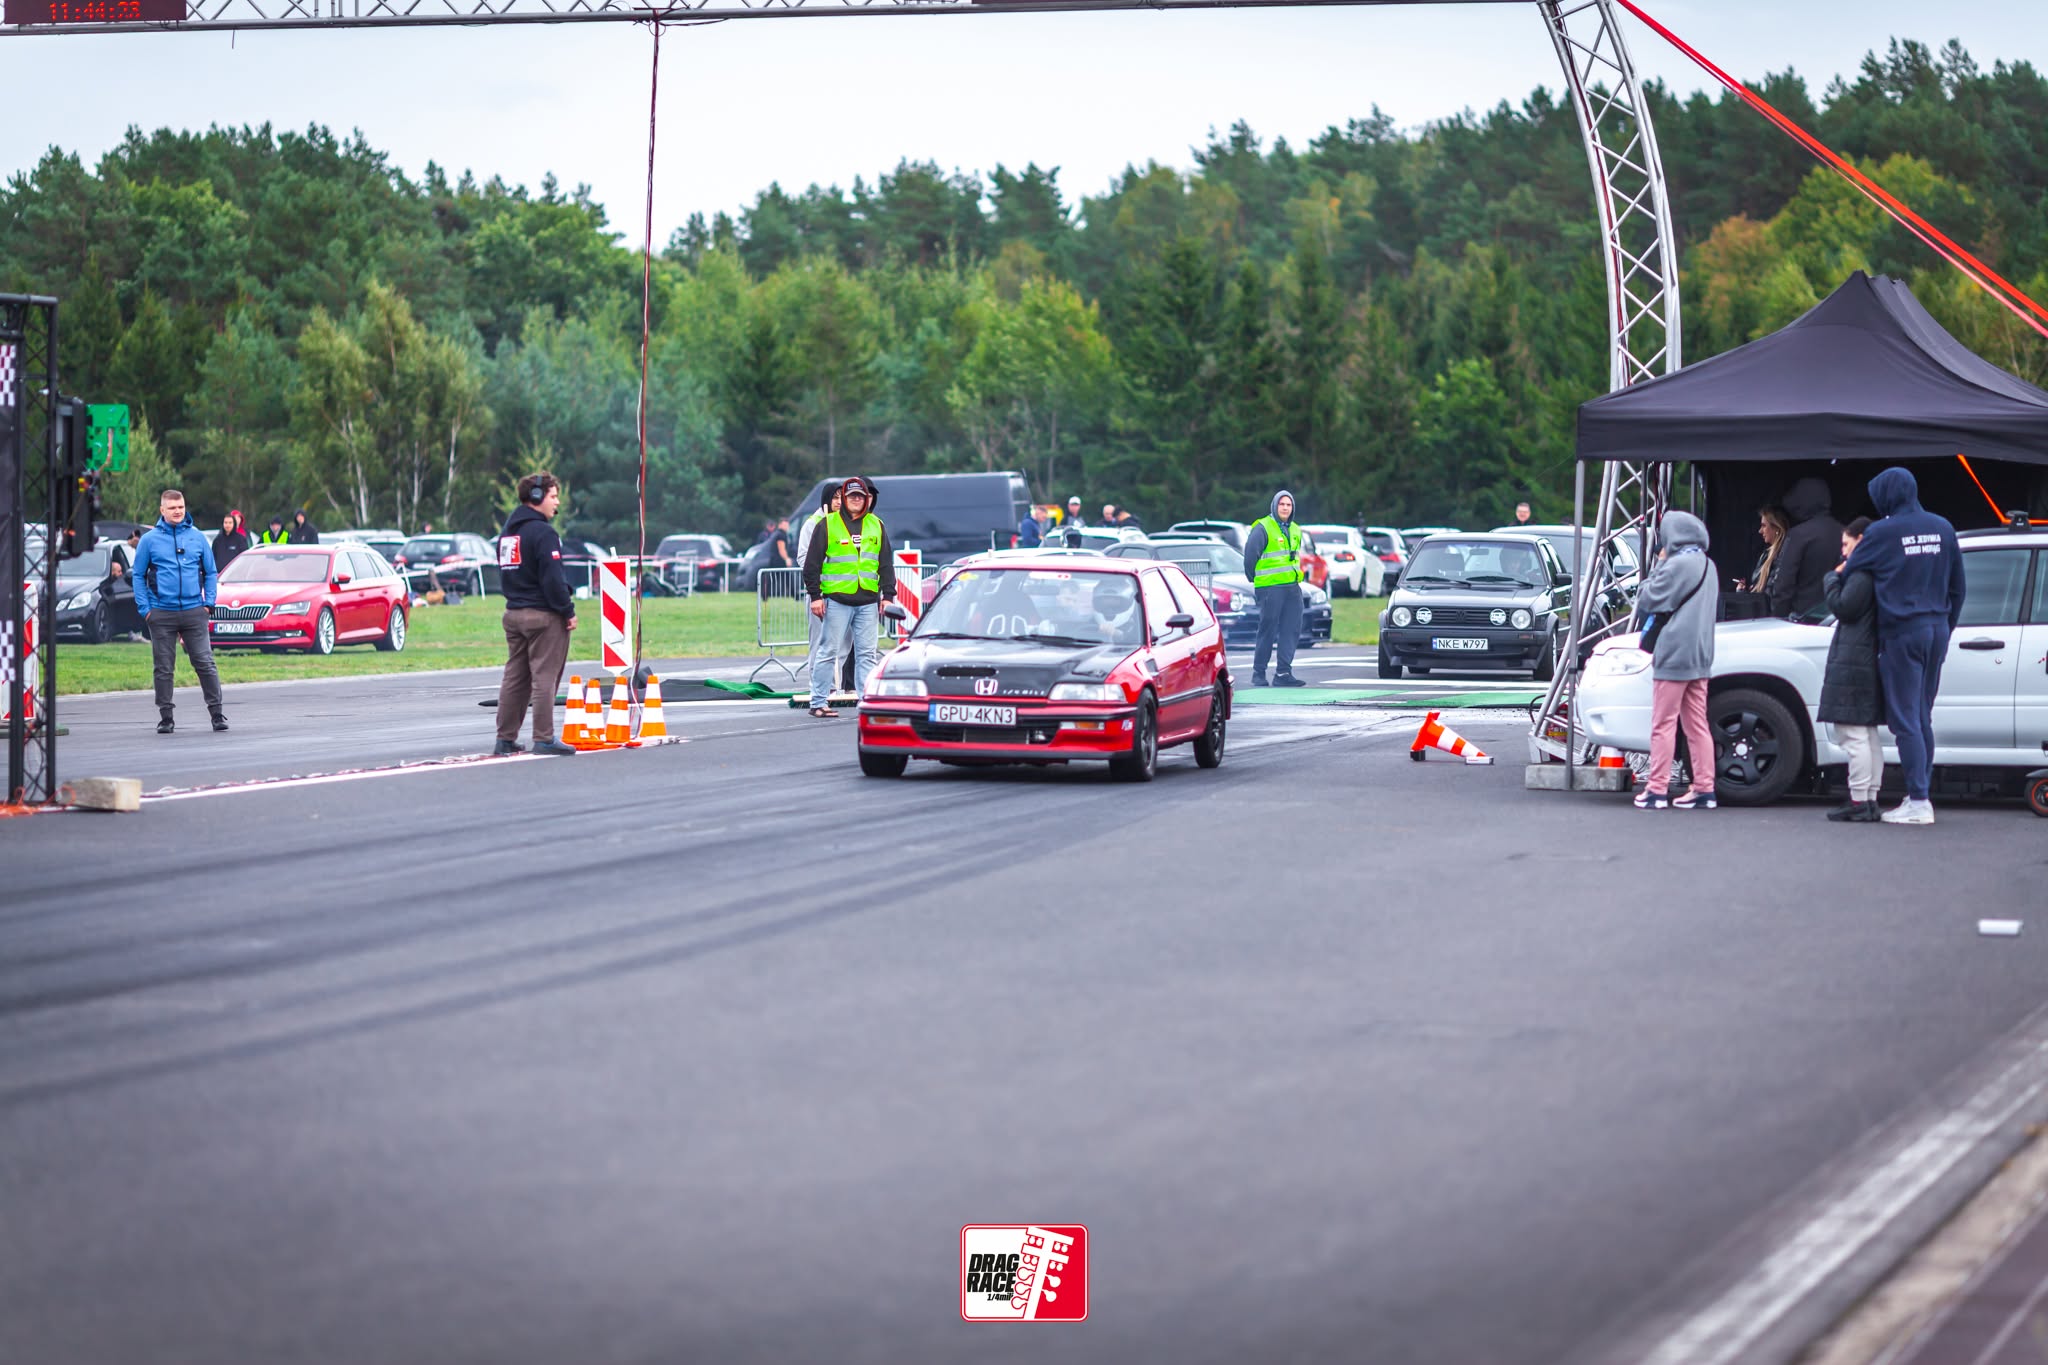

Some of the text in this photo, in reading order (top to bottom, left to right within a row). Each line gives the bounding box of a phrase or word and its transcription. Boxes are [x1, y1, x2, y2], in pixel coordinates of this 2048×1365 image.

[1438, 639, 1486, 649] NKE W797
[939, 706, 1013, 724] GPU 4KN3
